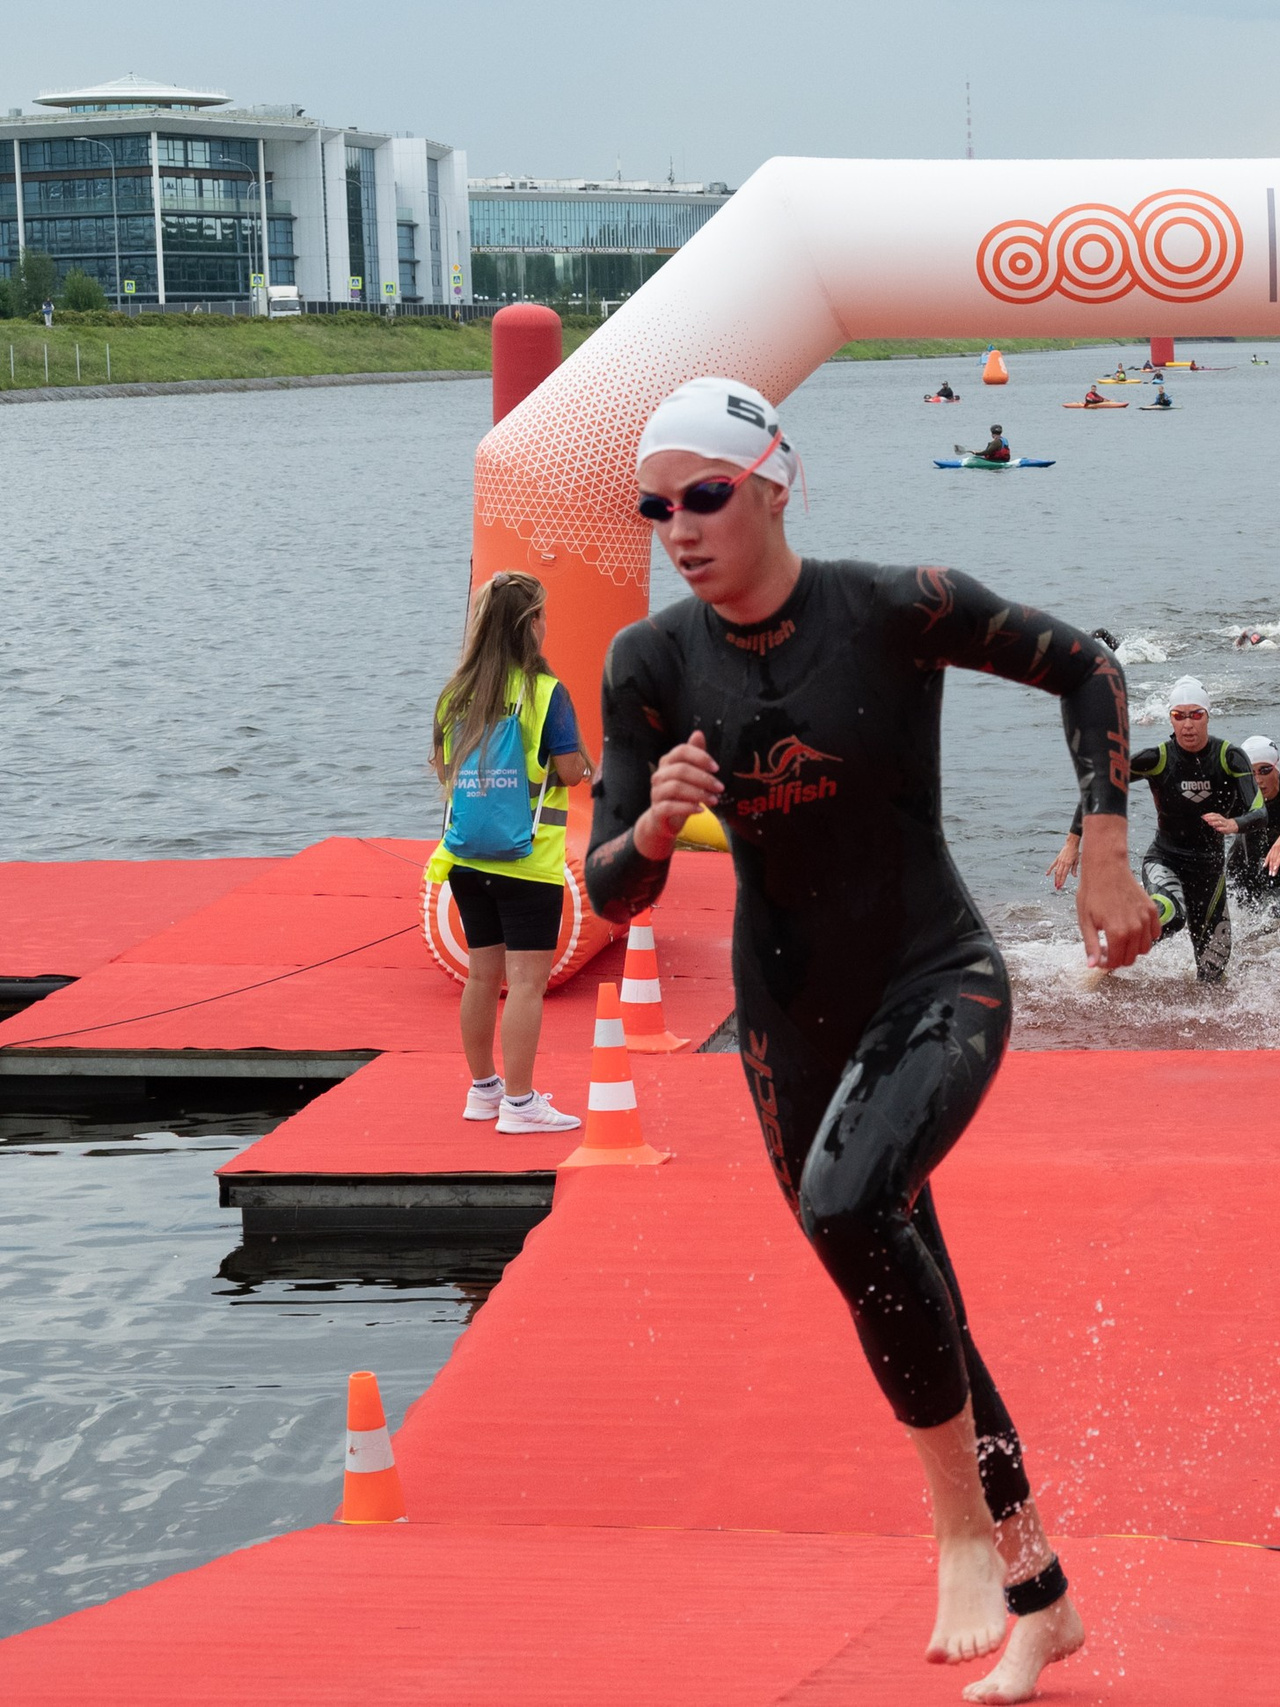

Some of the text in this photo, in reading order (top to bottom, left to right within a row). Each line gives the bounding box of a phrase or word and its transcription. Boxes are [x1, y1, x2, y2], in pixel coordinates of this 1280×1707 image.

[726, 619, 796, 656] sailfish
[737, 776, 837, 816] sailfish
[1180, 780, 1212, 791] arena
